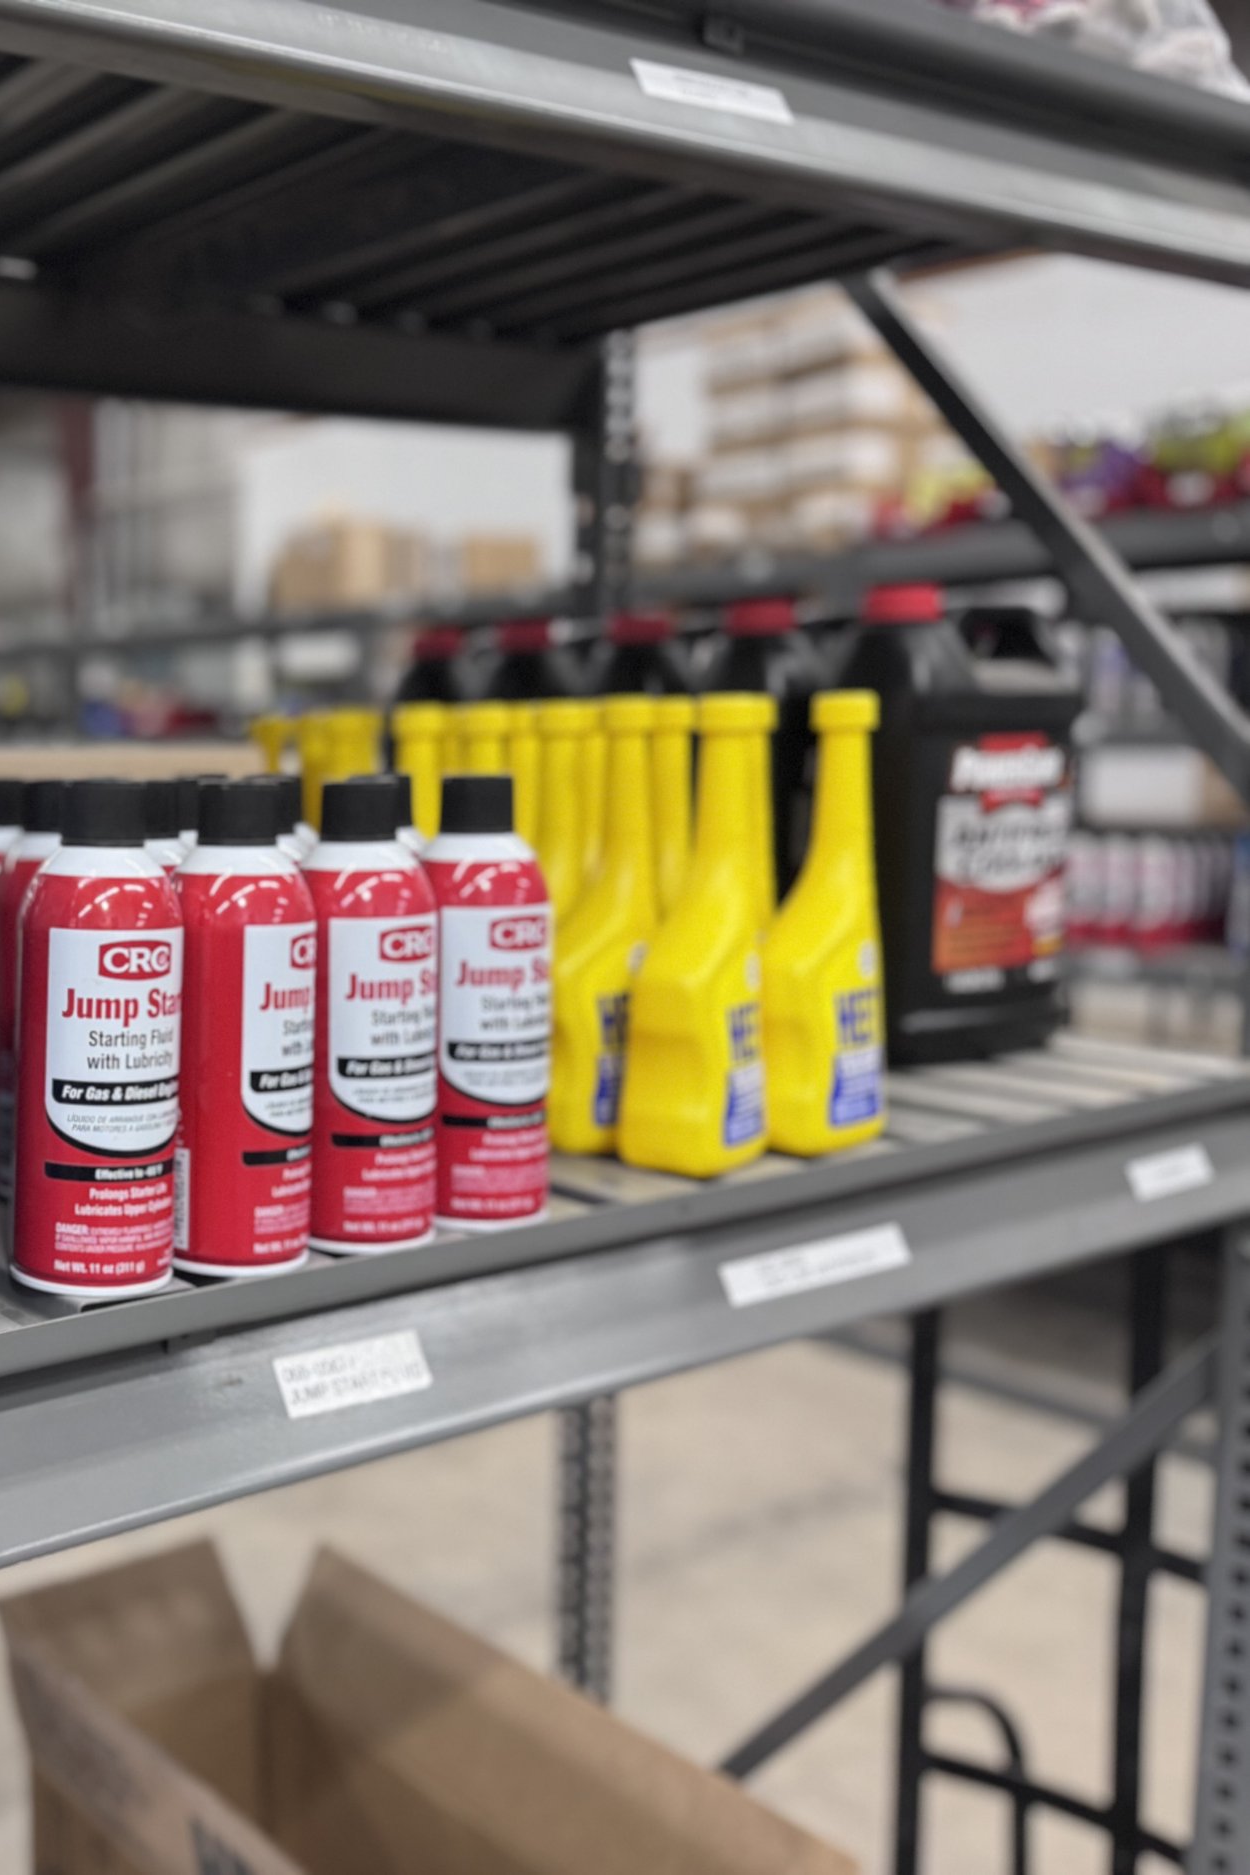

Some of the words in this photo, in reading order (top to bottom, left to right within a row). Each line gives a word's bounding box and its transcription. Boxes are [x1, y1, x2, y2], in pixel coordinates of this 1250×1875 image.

[103, 946, 171, 974] CRC
[346, 973, 414, 1007] Jump
[456, 960, 526, 993] Jump
[62, 988, 140, 1028] Jump
[89, 1030, 147, 1050] Starting
[87, 1054, 120, 1070] with
[62, 1085, 84, 1099] For
[85, 1086, 111, 1101] Gas
[111, 1086, 123, 1101] &
